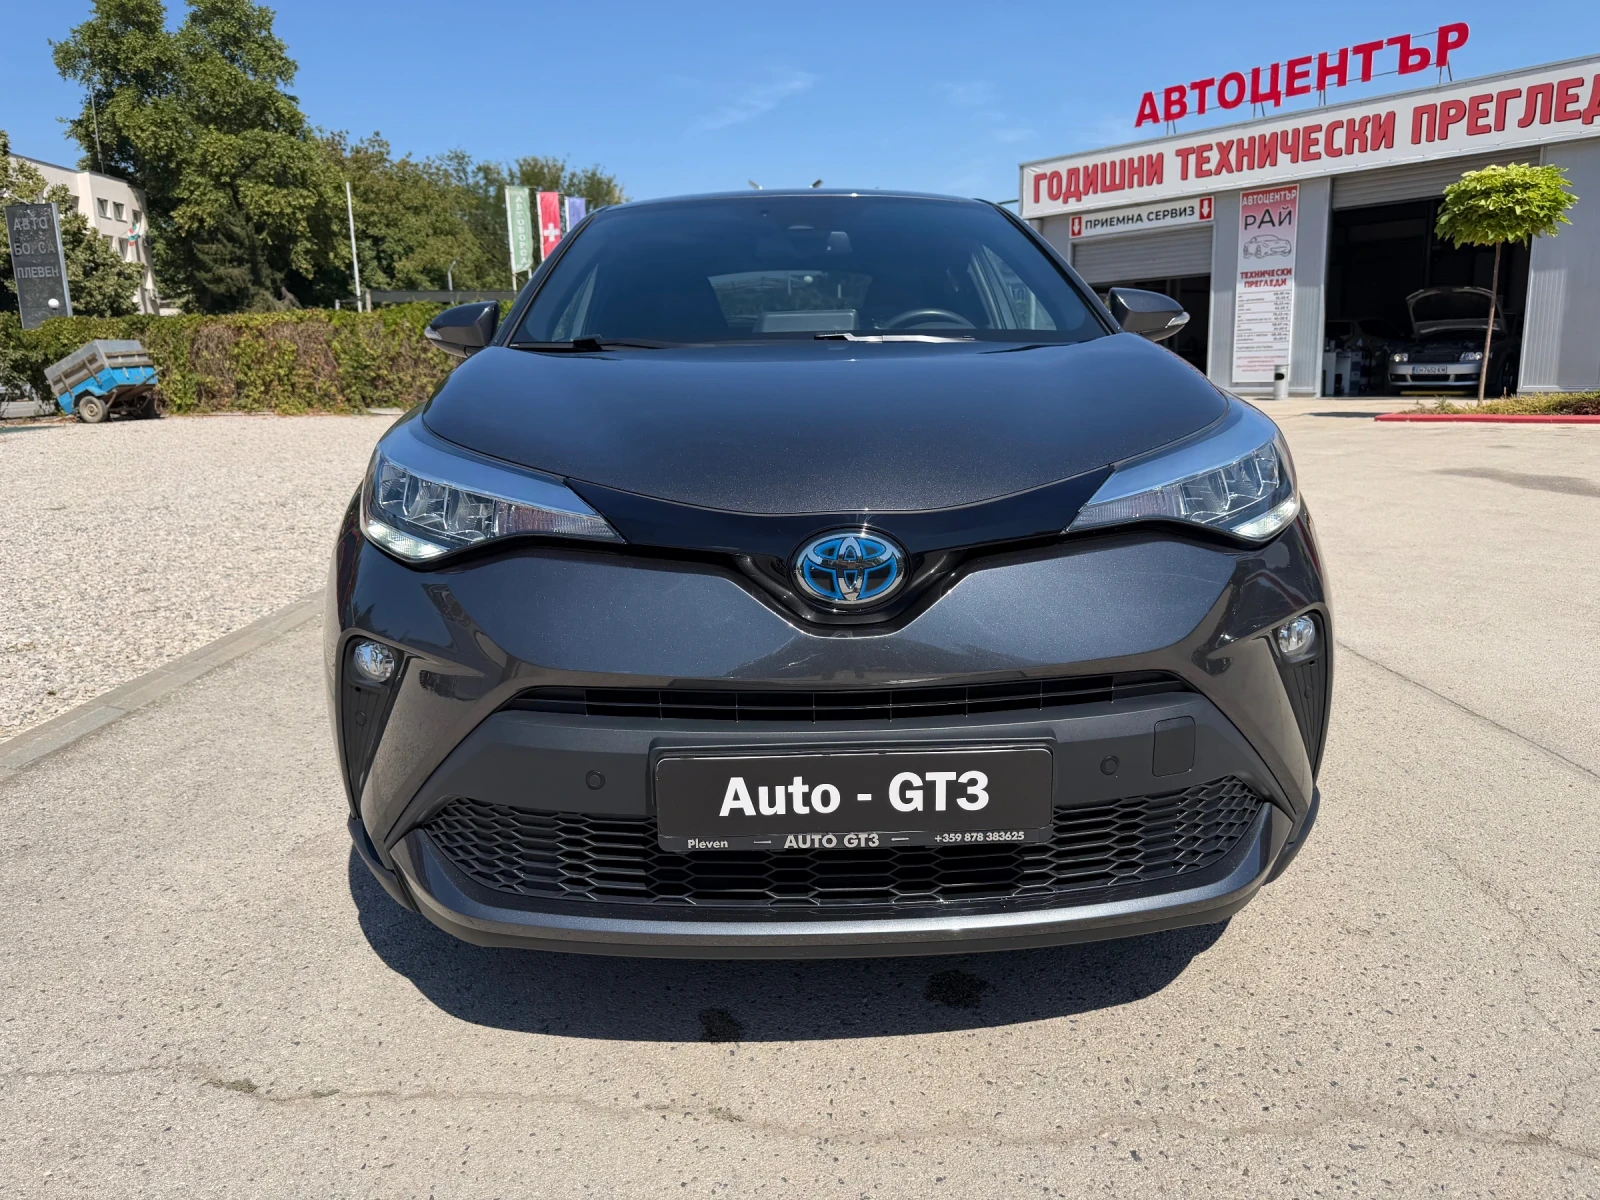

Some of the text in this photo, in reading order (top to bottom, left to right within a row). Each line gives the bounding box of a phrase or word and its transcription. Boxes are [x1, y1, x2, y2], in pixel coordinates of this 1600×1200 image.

[1134, 22, 1470, 128] АВТОЦЕНТЪР
[1033, 152, 1164, 204] ГОДИШНИ
[1175, 111, 1396, 181] ТЕХНИЧЕСКИ
[1242, 190, 1297, 206] АВТОЦЕНТЪР
[13, 217, 48, 231] АВТО
[1085, 206, 1195, 230] ПРИЕМНА СЕРВИЗ
[17, 266, 59, 279] ПЛЕВЕН
[1240, 267, 1292, 279] ТЕХНИЧЕСКИ
[1244, 278, 1287, 288] ПРЕГЛЕДИ
[719, 776, 841, 817] Auto
[888, 770, 989, 812] GT3
[687, 839, 729, 849] Pleven
[784, 833, 880, 849] AUTO GT3
[934, 831, 1025, 843] +359 878 383625
